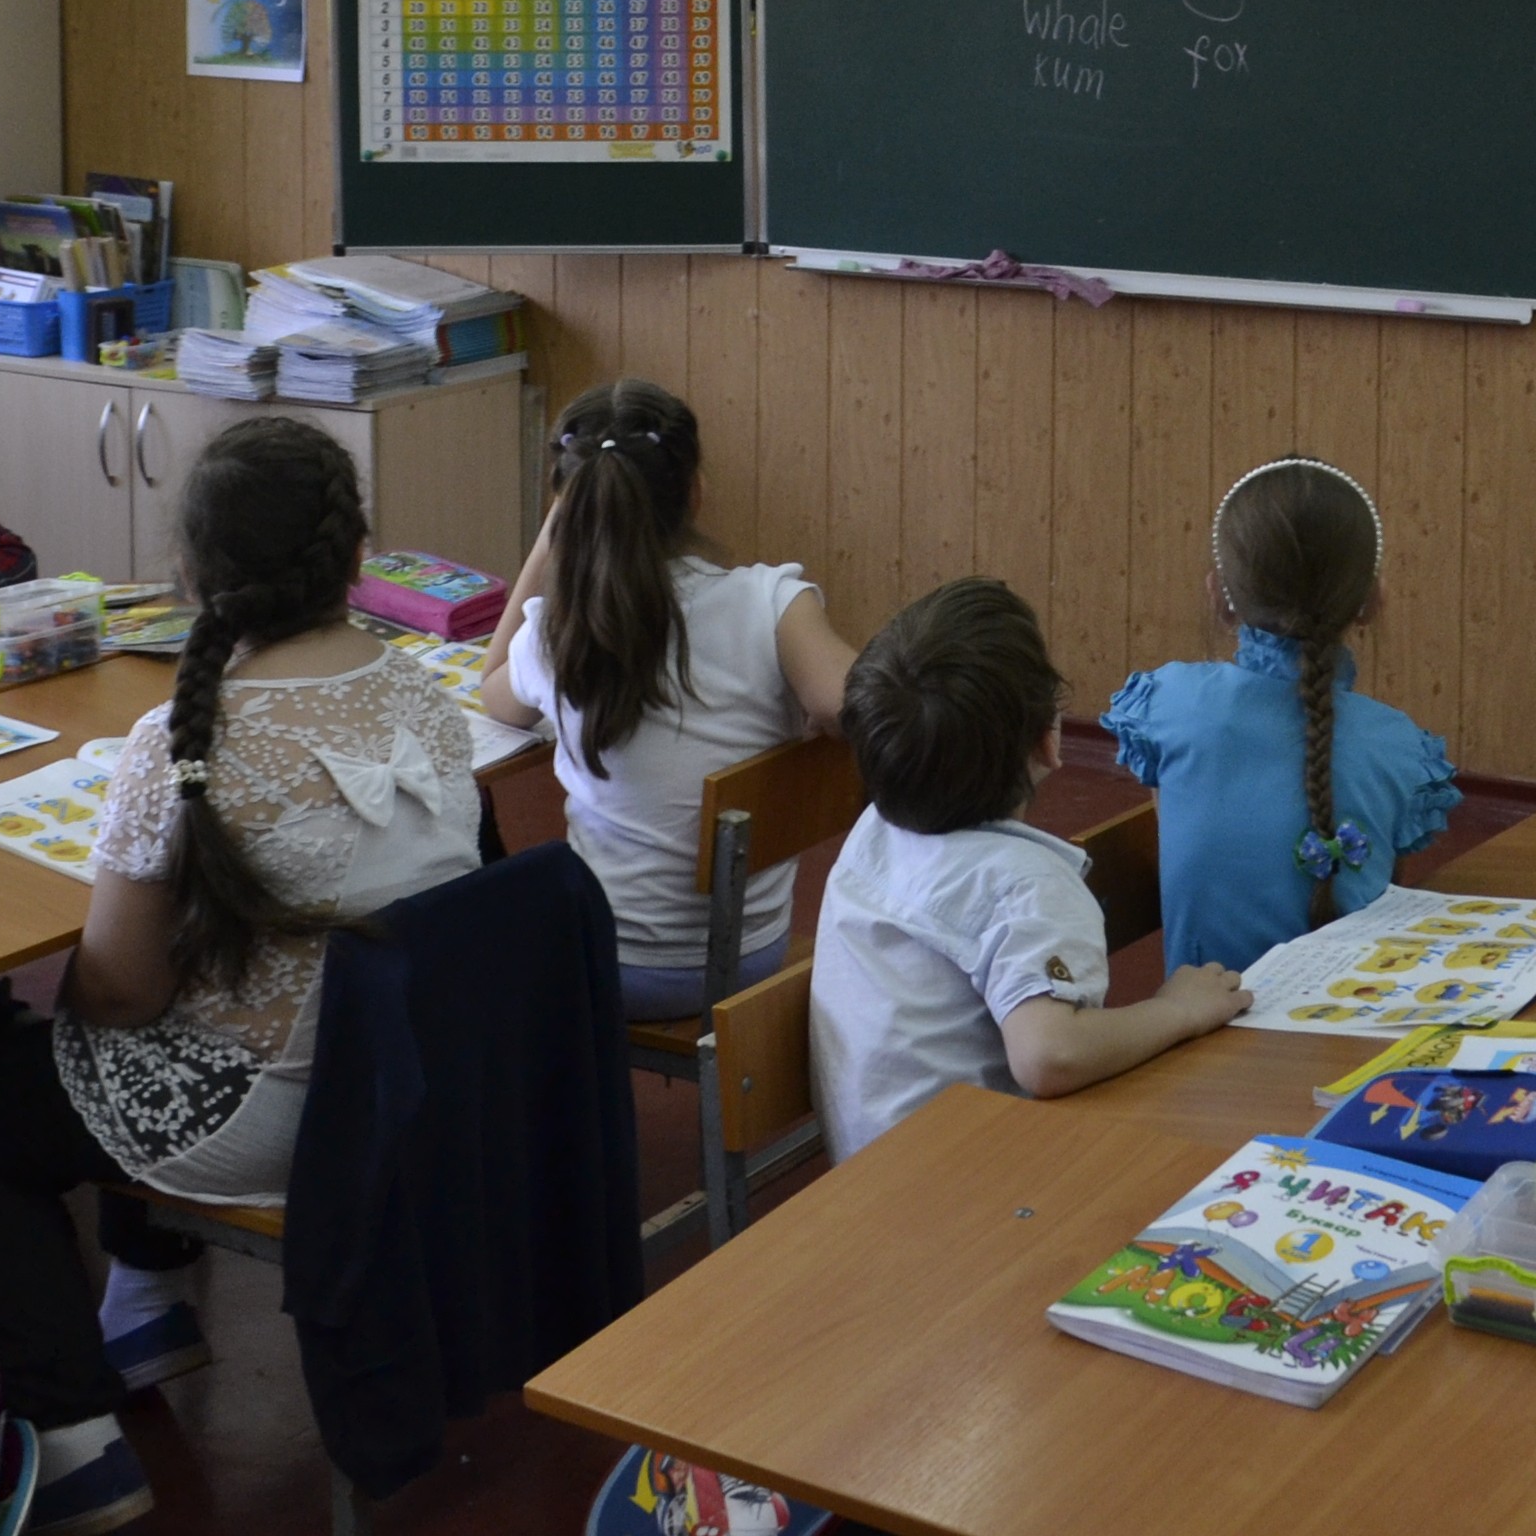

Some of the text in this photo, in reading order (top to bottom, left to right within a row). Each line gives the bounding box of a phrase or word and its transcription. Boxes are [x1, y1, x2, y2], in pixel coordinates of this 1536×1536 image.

[1184, 35, 1249, 88] fox
[1286, 1209, 1361, 1237] Буквар
[1293, 1232, 1322, 1254] 1
